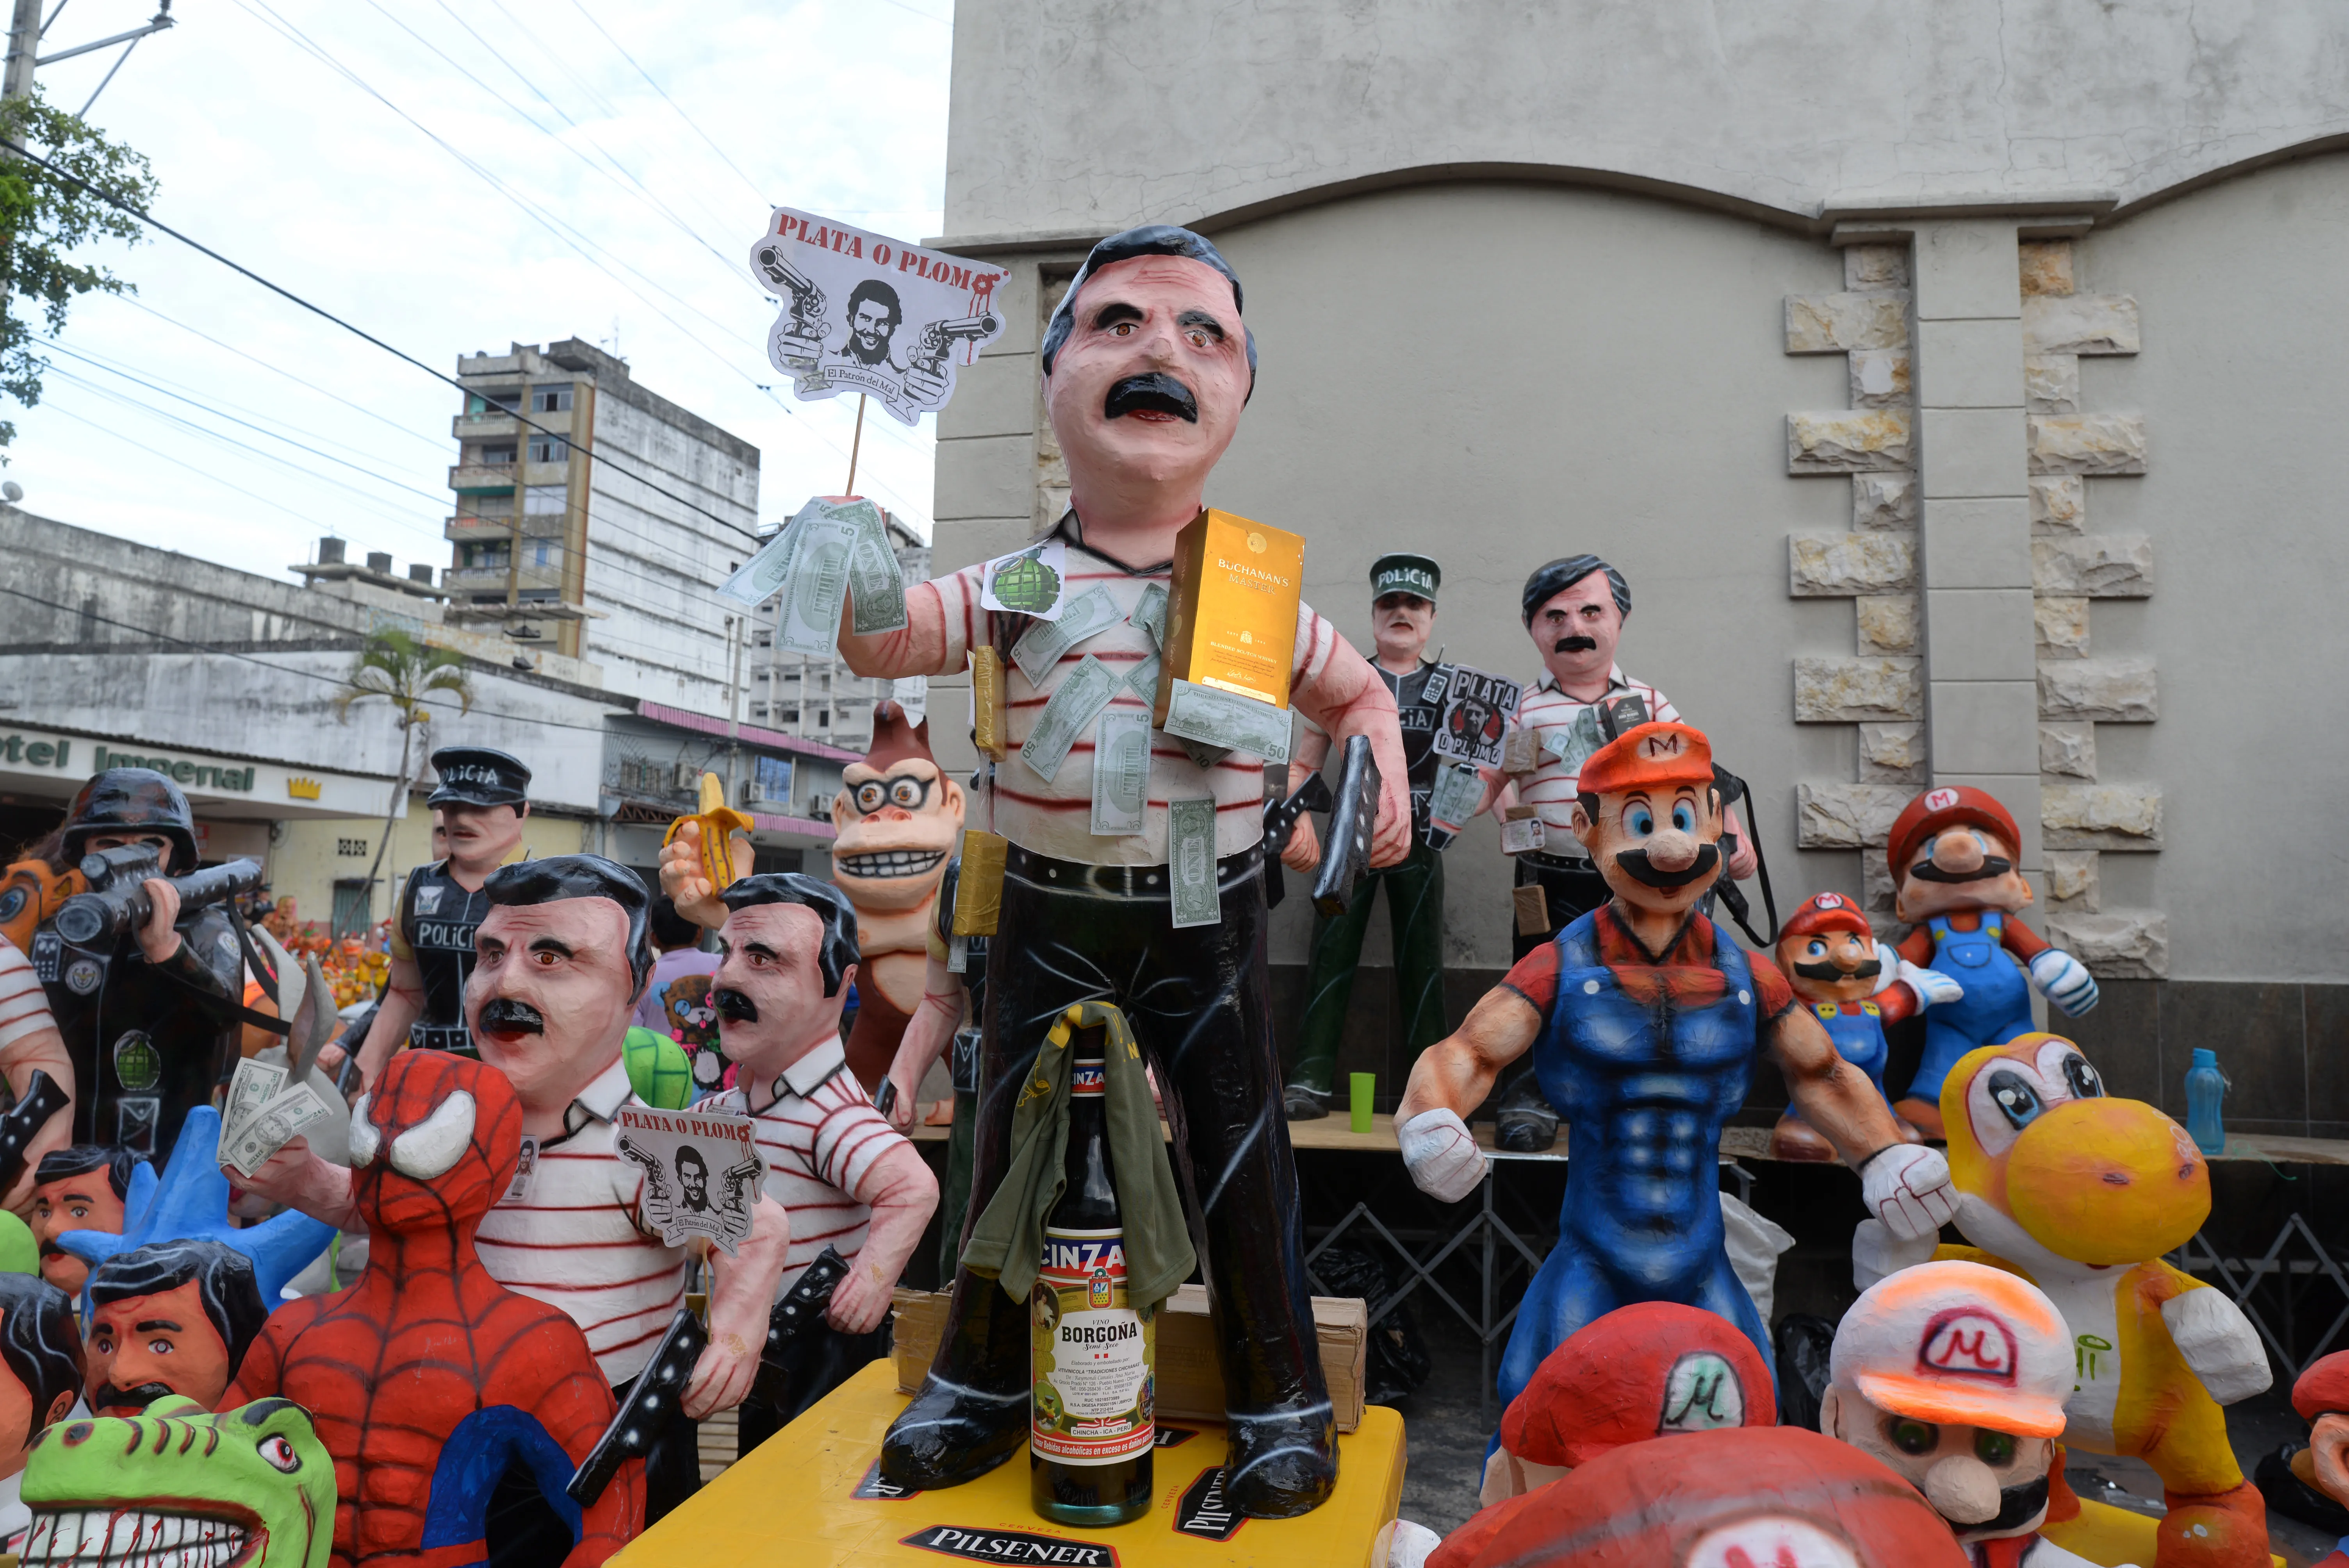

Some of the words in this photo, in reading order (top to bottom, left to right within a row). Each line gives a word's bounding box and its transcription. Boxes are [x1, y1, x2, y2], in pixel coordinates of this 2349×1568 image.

[777, 214, 863, 258] PLATA
[873, 244, 891, 265] O
[898, 250, 993, 295] PLOMO
[828, 369, 836, 377] El
[838, 370, 864, 382] Patrón
[867, 375, 879, 386] del
[880, 378, 895, 394] Mal
[818, 502, 832, 515] 5
[840, 526, 855, 536] 5
[877, 529, 888, 551] UNITED
[885, 551, 896, 573] STATES
[894, 573, 899, 581] OF
[786, 590, 794, 611] UNITED
[790, 570, 798, 591] STATES
[796, 543, 806, 564] AMERICA
[857, 542, 884, 591] ONE
[1218, 559, 1289, 587] BUCHANAN'S
[1229, 574, 1276, 595] MASTER
[1014, 648, 1022, 660] 5
[1210, 641, 1235, 652] BLENDED
[1236, 649, 1257, 658] SCOTCH
[1257, 655, 1278, 664] WHISKY
[1454, 673, 1517, 709] PLATA
[1192, 691, 1205, 699] THE
[1205, 693, 1224, 703] UNITED
[1224, 697, 1244, 707] STATES
[1250, 706, 1274, 720] AMERICA
[1022, 741, 1035, 759] 50
[1267, 743, 1287, 760] 50
[1440, 734, 1449, 749] O
[1649, 733, 1677, 757] M
[94, 745, 255, 792] Imperial
[1195, 752, 1210, 768] 10
[1932, 789, 1952, 808] M
[1187, 839, 1202, 882] ONE
[1819, 893, 1839, 905] M
[621, 1112, 673, 1132] PLATA
[676, 1119, 687, 1133] O
[692, 1119, 750, 1142] PLOMO
[684, 1218, 699, 1228] Patrón
[709, 1223, 719, 1232] Mal
[1062, 1321, 1137, 1343] BORGOÑA
[1936, 1329, 2001, 1368] M
[1119, 1361, 1141, 1371] CHICHANAS"
[1117, 1424, 1130, 1432] PERÚ
[1034, 1435, 1043, 1447] Tomar
[1044, 1440, 1060, 1452] Bebidas
[1062, 1445, 1092, 1455] alcohólicas
[1102, 1445, 1121, 1454] exceso
[1122, 1443, 1127, 1451] es
[1161, 1485, 1180, 1509] CERVEZA
[999, 1523, 1062, 1534] CERVEZA
[929, 1528, 1100, 1566] PILSENER
